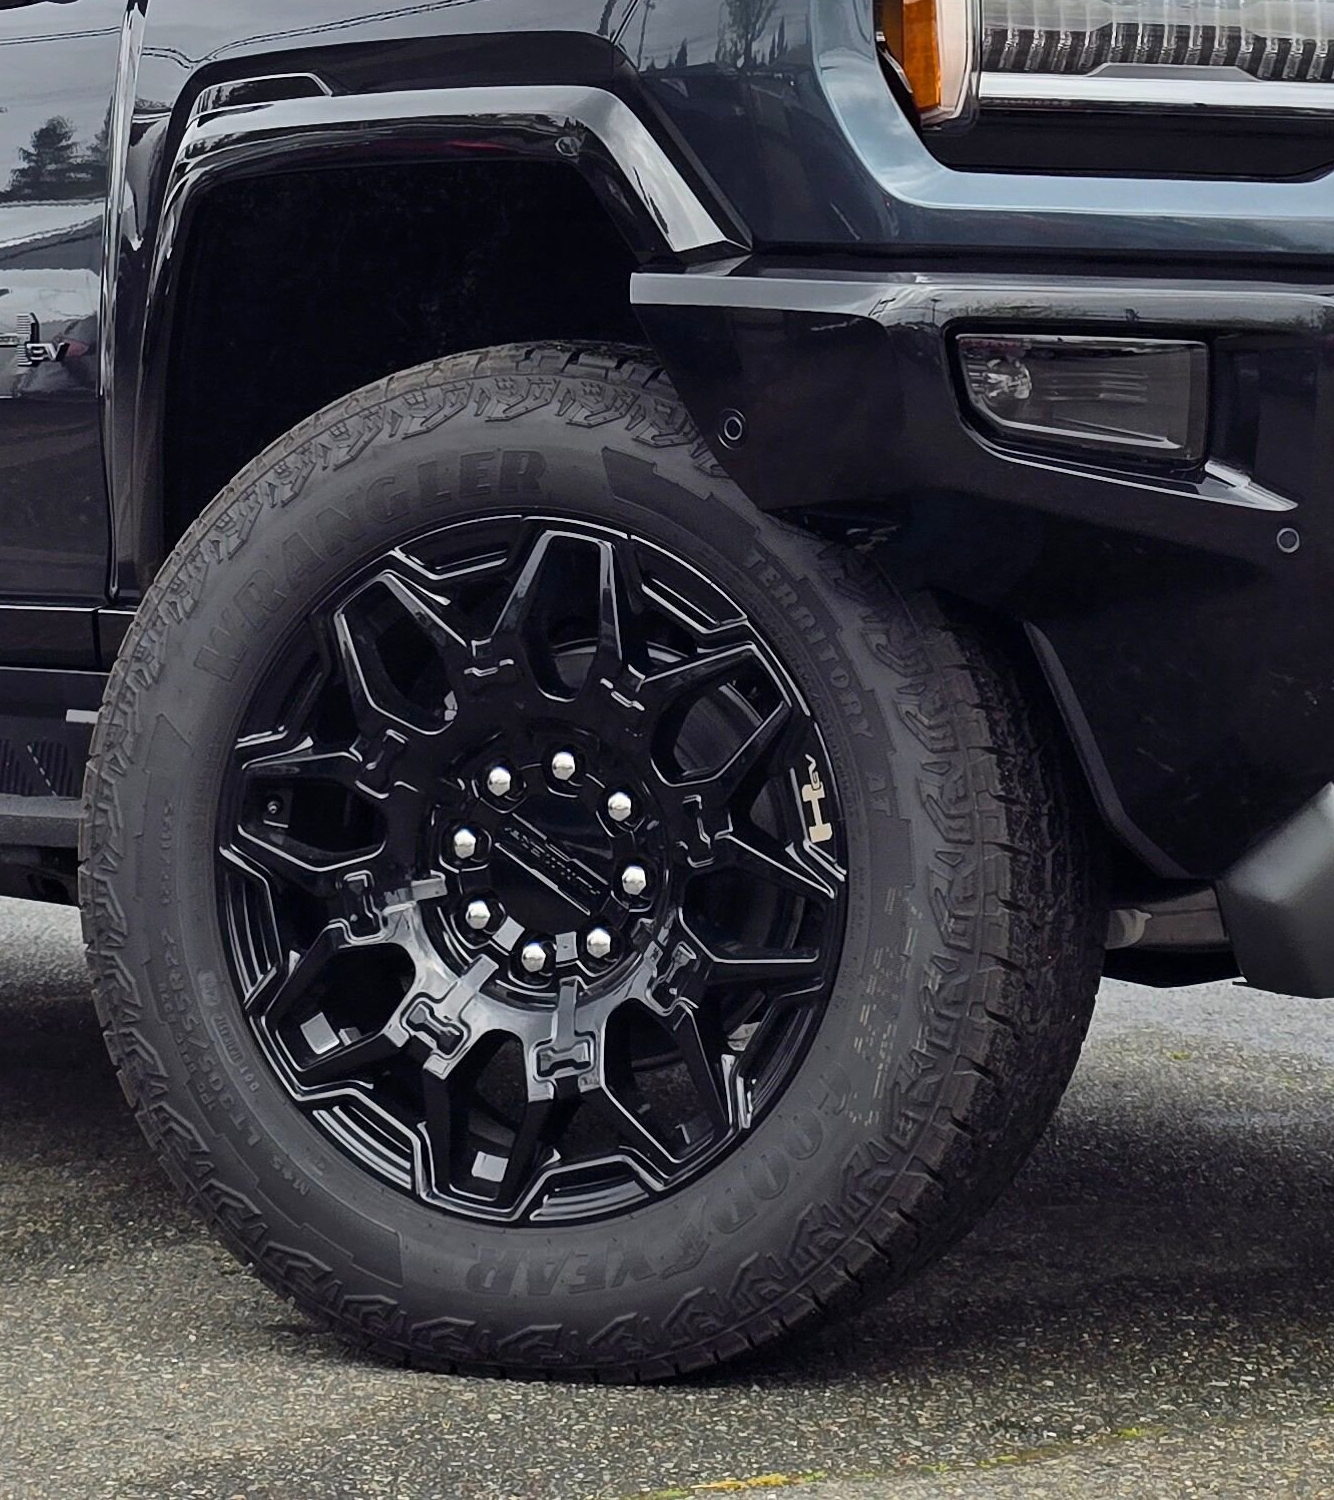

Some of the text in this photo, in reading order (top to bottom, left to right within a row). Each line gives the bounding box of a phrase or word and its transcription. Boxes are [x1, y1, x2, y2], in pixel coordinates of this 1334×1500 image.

[193, 449, 548, 683] WRANGLER
[743, 548, 875, 740] TERRITORY
[464, 1058, 855, 1299] GOODYEAR
